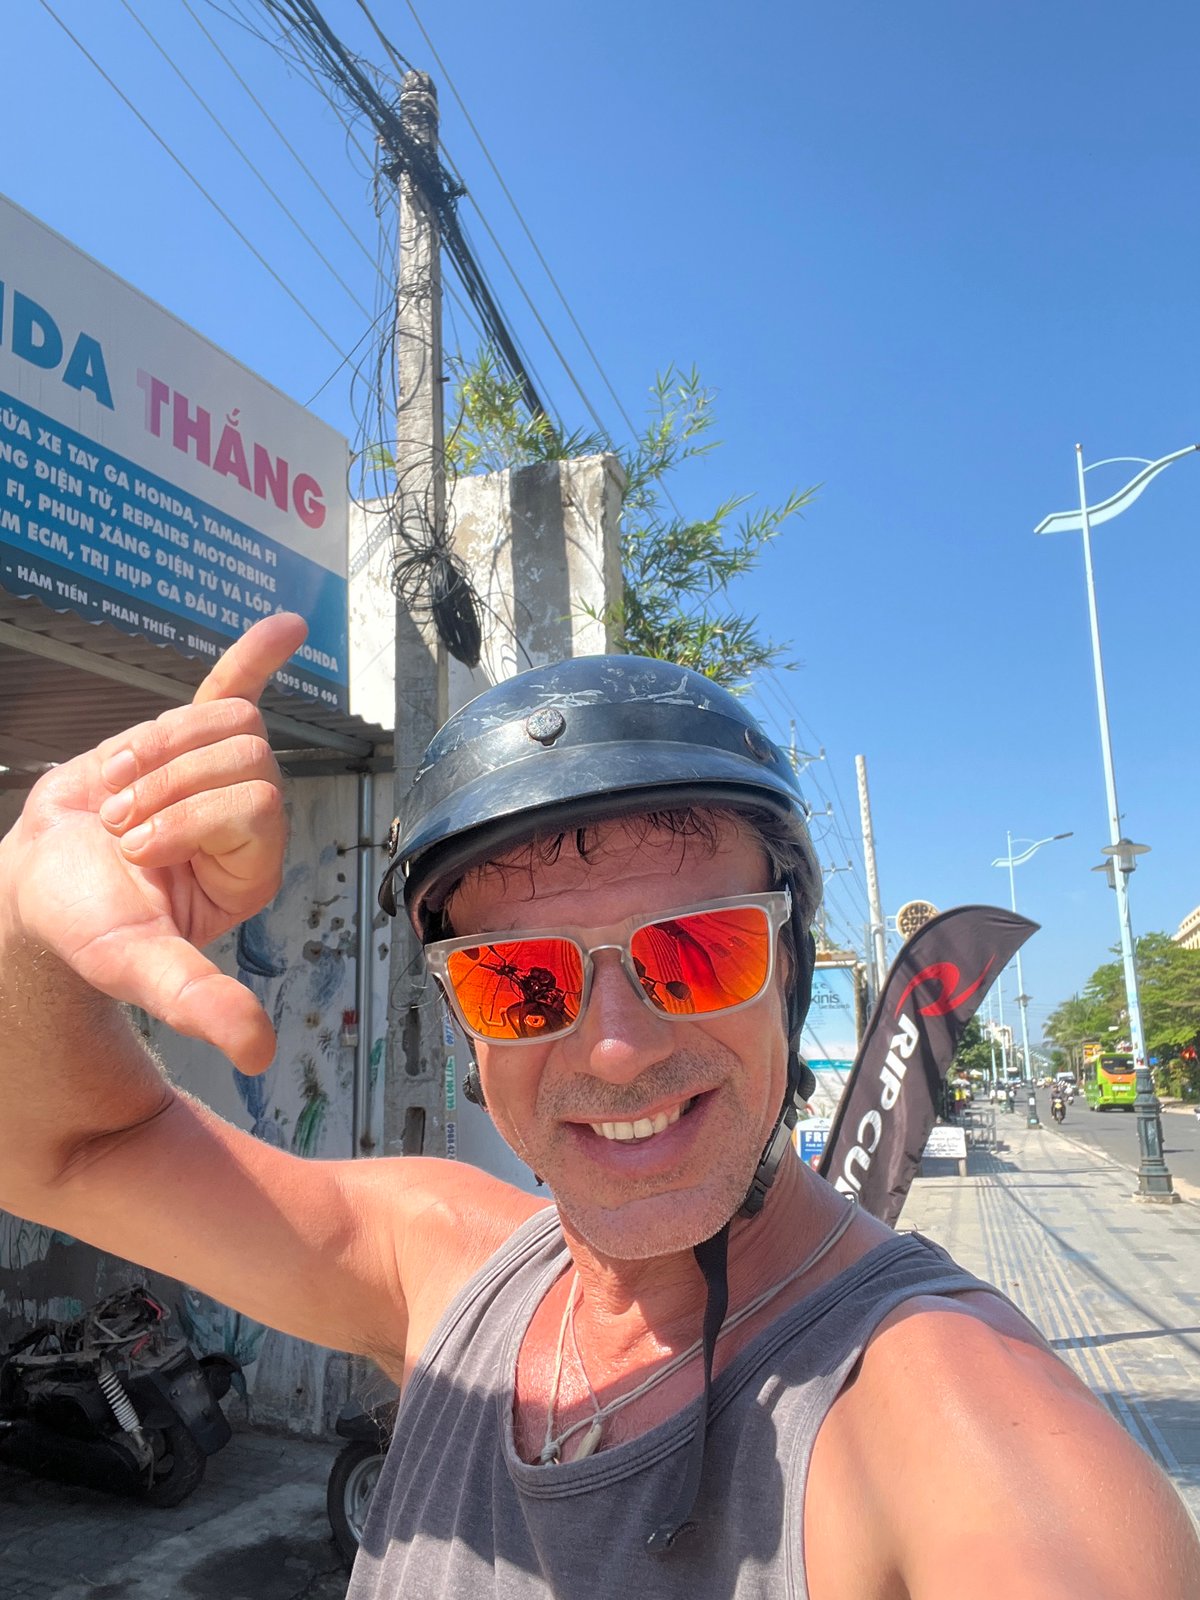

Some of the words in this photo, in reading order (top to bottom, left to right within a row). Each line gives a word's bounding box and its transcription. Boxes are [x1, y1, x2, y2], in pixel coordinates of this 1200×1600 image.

[0, 280, 115, 411] DA
[137, 368, 326, 529] THẮNG
[0, 407, 32, 440] ỬA
[37, 427, 62, 455] XE
[67, 443, 100, 473] TAY
[104, 464, 130, 491] GA
[135, 479, 199, 529] HONDA,
[202, 514, 262, 560] YAMAHA
[34, 459, 83, 498] ĐIỆN
[122, 502, 190, 550] REPAIRS
[193, 539, 277, 593] MOTORBIKE
[28, 521, 74, 561] ECM,
[80, 544, 110, 576] TRỊ
[157, 579, 181, 603] GA
[221, 606, 240, 629] XE
[38, 492, 95, 535] PHUN
[99, 522, 151, 559] XĂNG
[155, 548, 194, 581] ĐIỆN
[56, 581, 88, 605] TIẾN
[102, 600, 139, 625] PHAN
[142, 616, 176, 640] THIẾT
[276, 670, 300, 689] 0395
[302, 681, 319, 697] 055
[321, 689, 338, 705] 496
[879, 1013, 919, 1111] RIP
